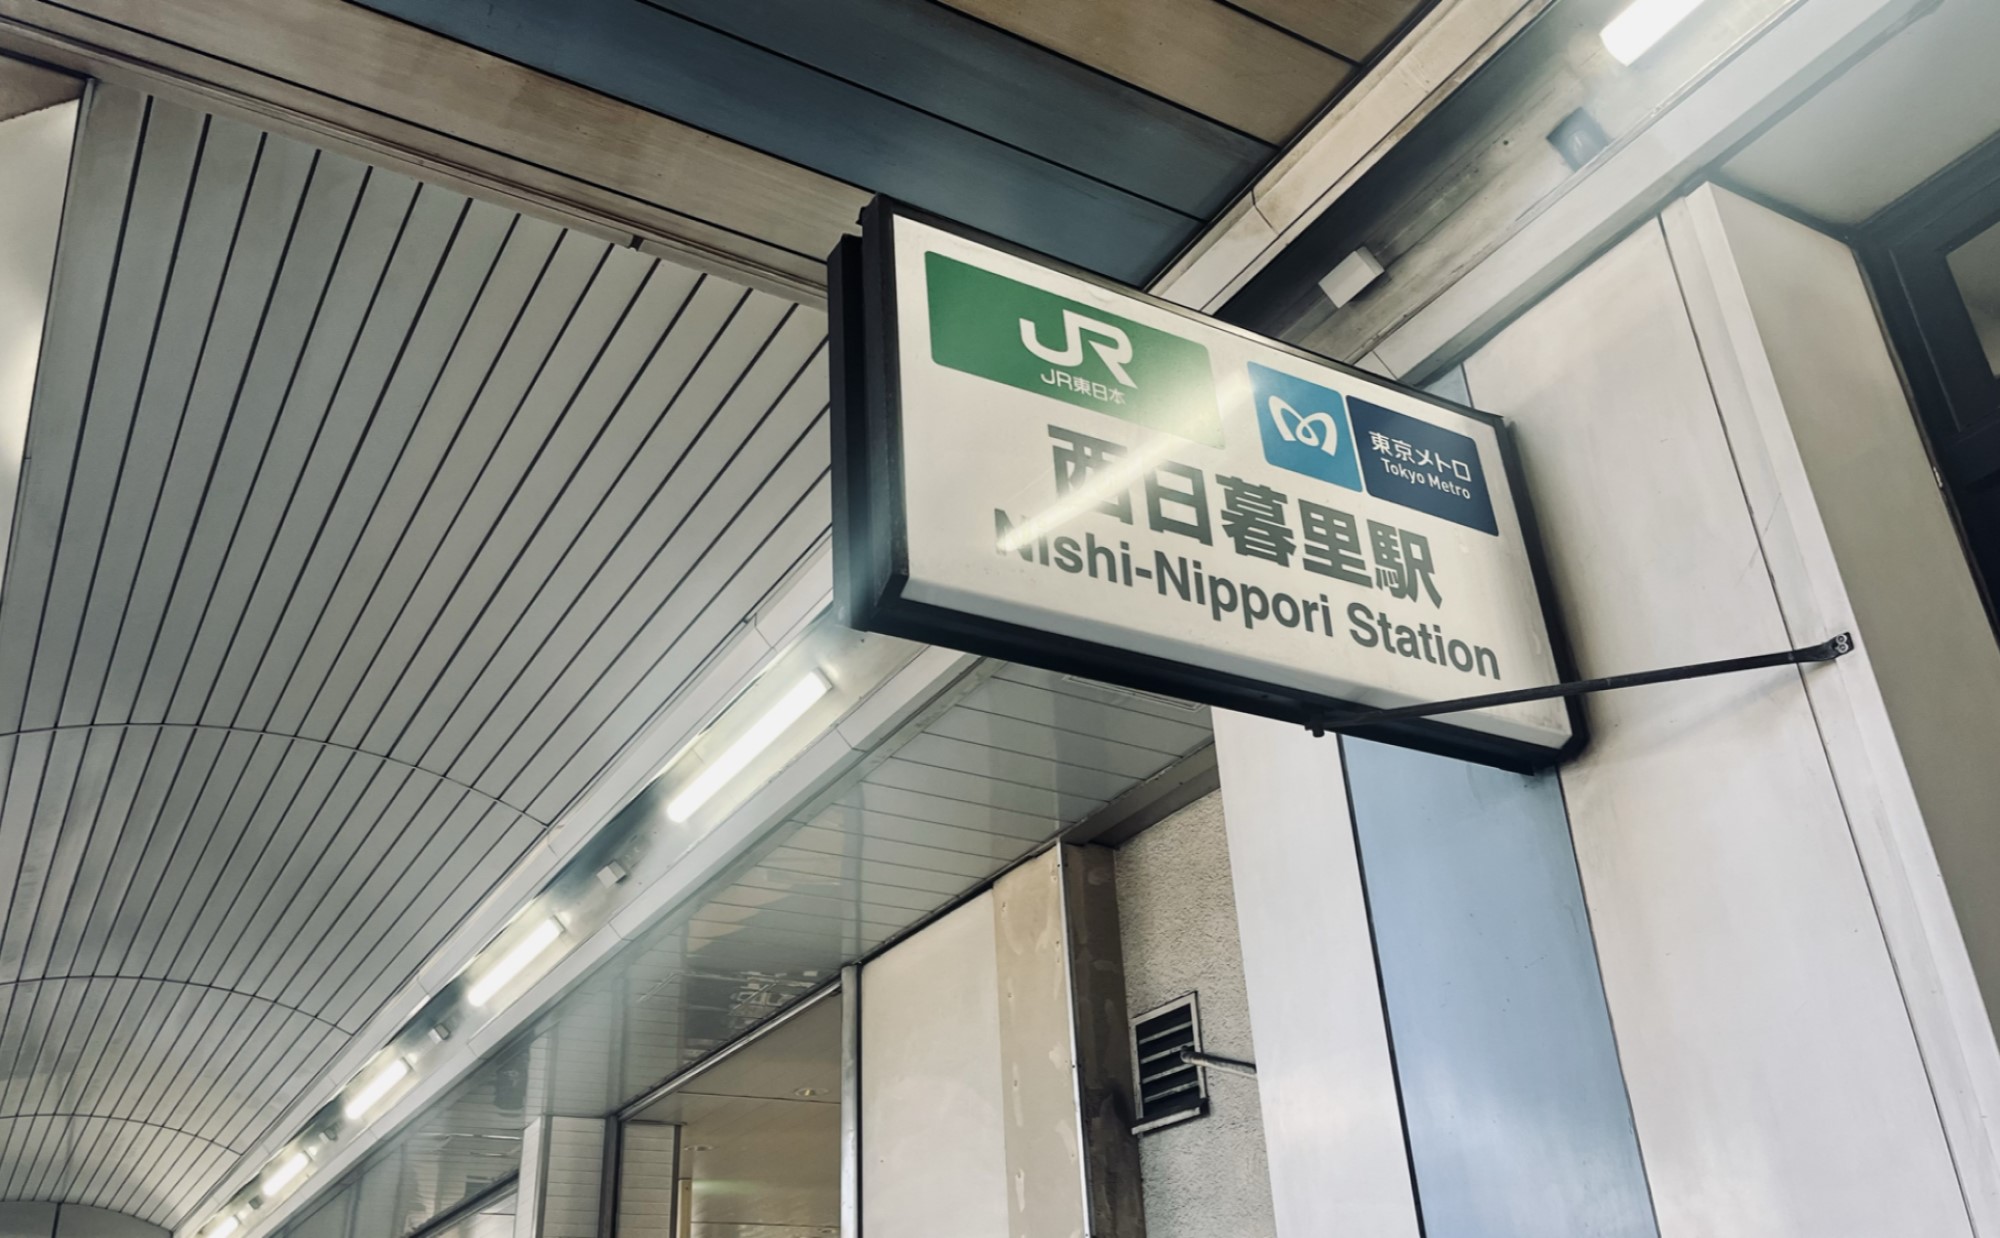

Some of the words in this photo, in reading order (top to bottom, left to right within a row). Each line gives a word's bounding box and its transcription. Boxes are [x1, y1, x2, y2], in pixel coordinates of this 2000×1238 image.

[1019, 309, 1138, 389] JR
[1040, 369, 1126, 405] JR東日本
[1369, 431, 1471, 482] 東京メトロ
[1380, 458, 1425, 484] Tokyo
[1429, 474, 1471, 499] Metro
[1047, 424, 1442, 609] 西日暮里駅
[1347, 601, 1501, 681] Station
